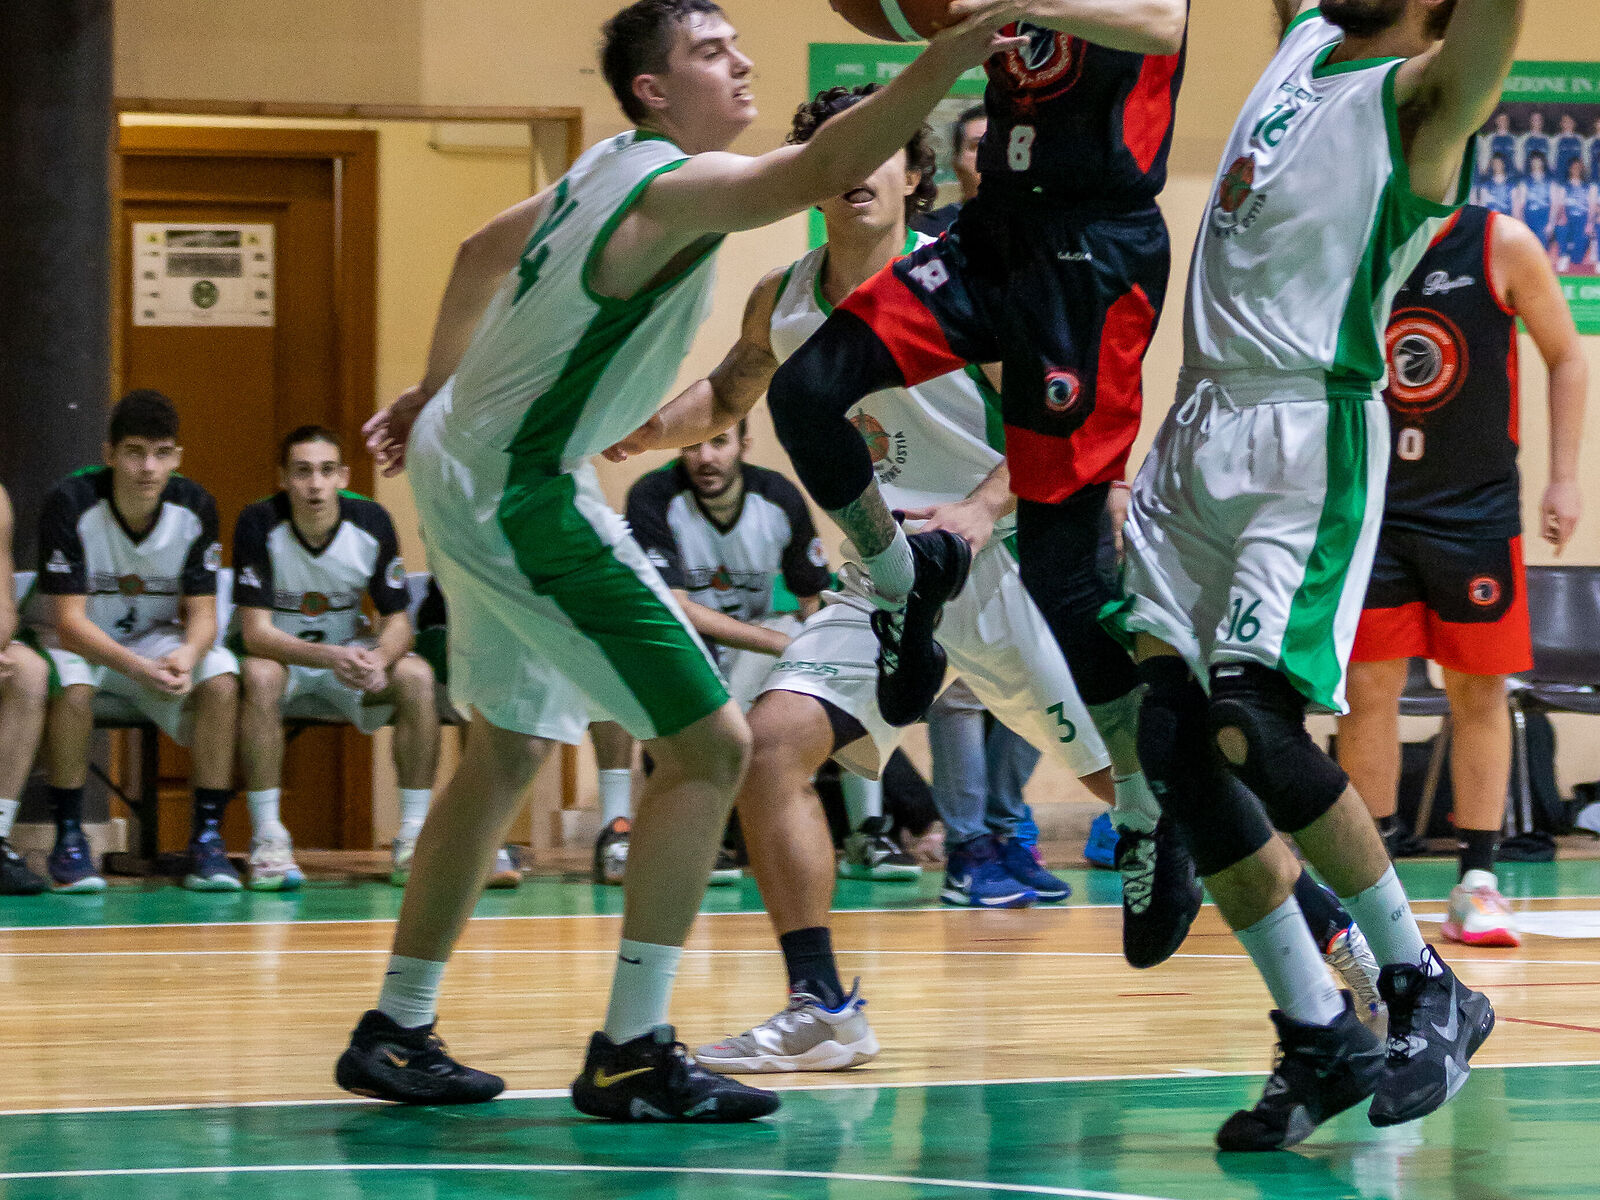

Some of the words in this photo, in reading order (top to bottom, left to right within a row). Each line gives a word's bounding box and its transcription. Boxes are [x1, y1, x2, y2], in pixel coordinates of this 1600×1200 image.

[1252, 104, 1297, 147] 16
[1007, 125, 1036, 171] 8
[894, 430, 908, 464] OSTIA
[1397, 427, 1425, 460] 0
[1227, 597, 1262, 643] 16
[1047, 701, 1077, 744] 3
